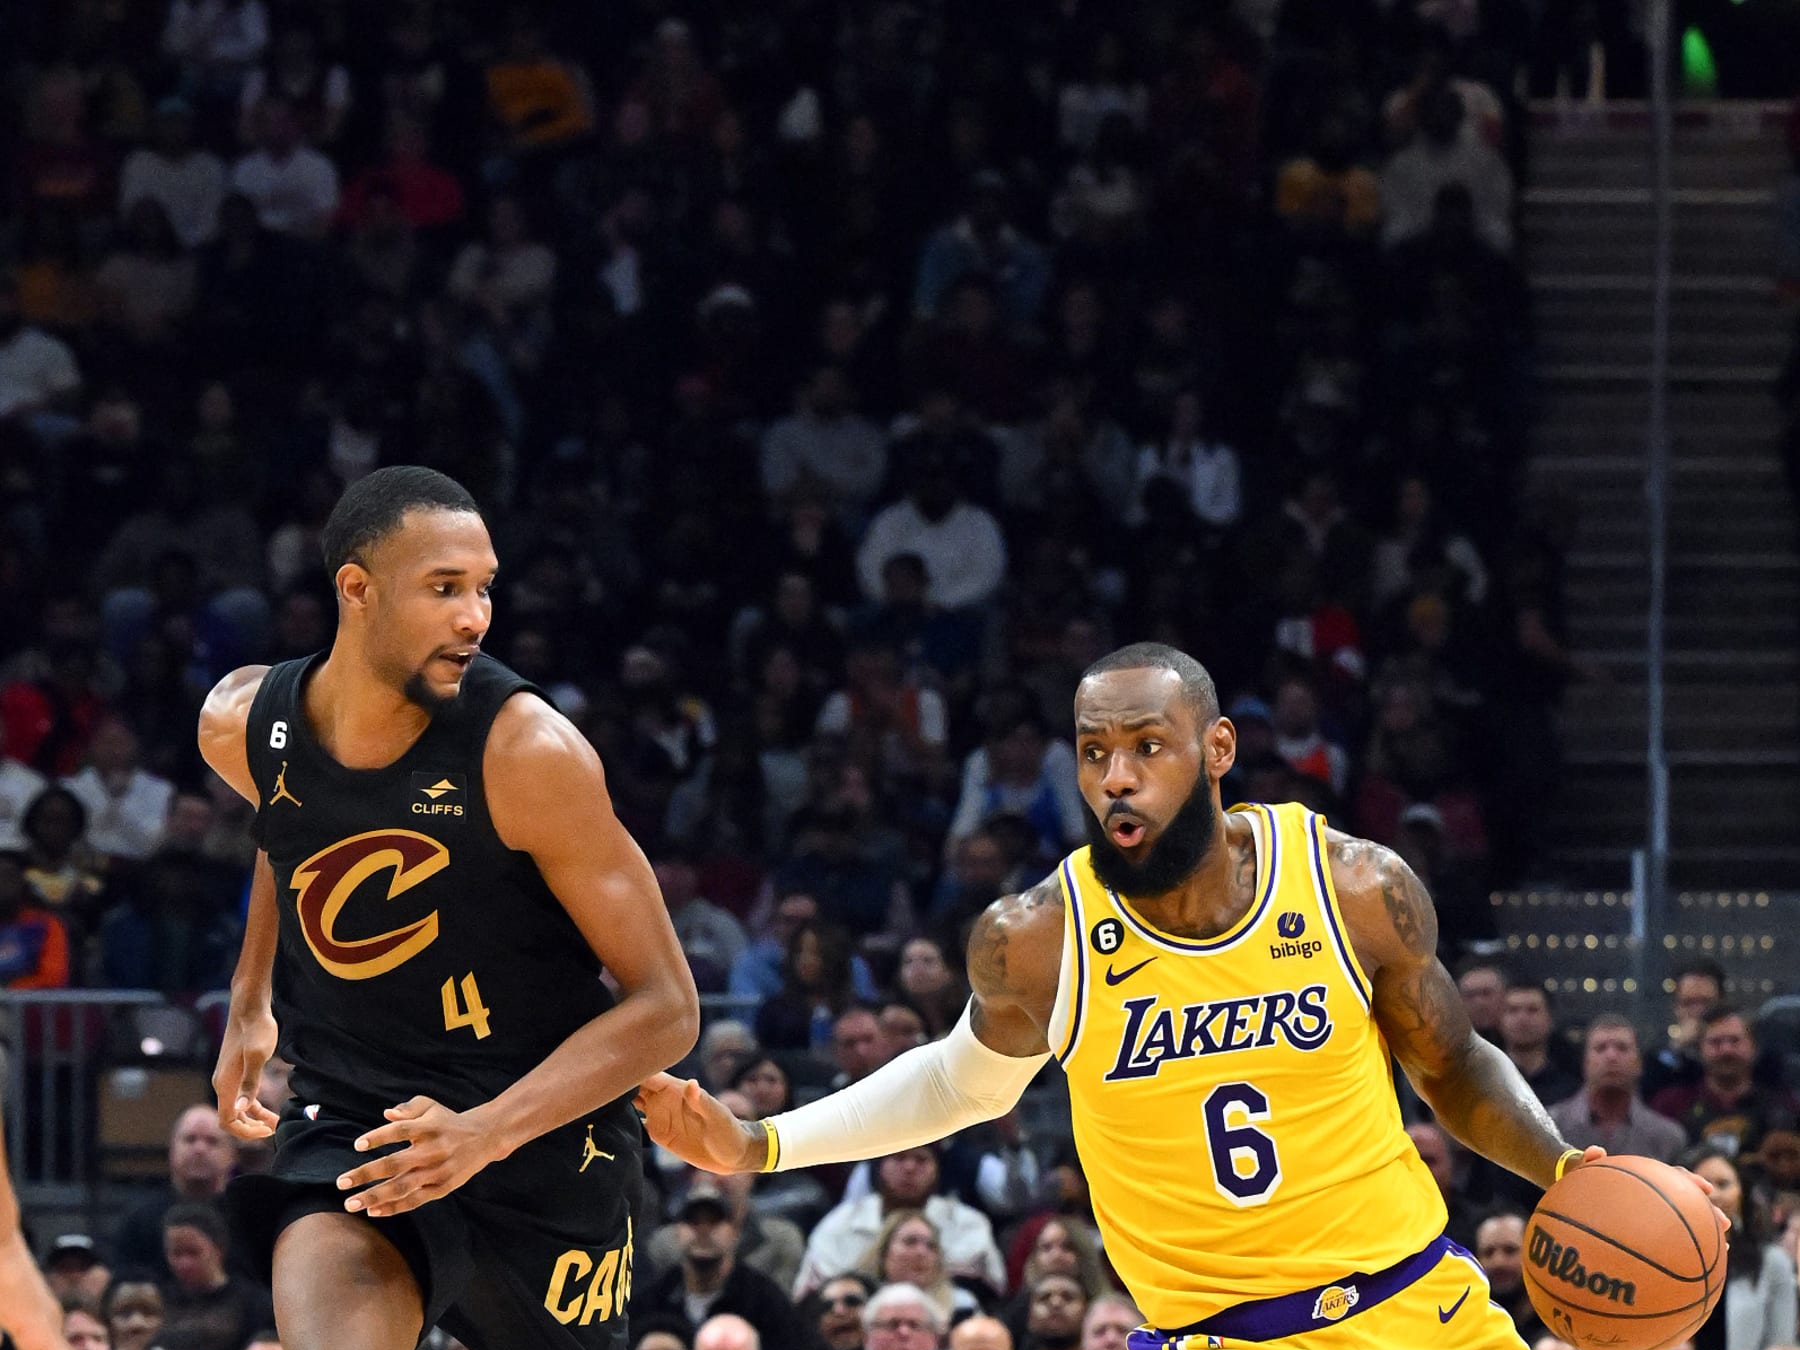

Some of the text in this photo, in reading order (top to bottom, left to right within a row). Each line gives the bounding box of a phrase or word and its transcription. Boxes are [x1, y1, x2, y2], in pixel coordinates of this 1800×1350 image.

[269, 720, 288, 750] 6
[411, 802, 463, 816] CLIFFS
[289, 828, 450, 981] C
[1098, 923, 1117, 951] 6
[1270, 940, 1322, 960] bibigo
[441, 970, 492, 1041] 4
[1103, 983, 1333, 1082] LAKERS
[1201, 1080, 1284, 1208] 6
[1529, 1225, 1636, 1306] Wilson
